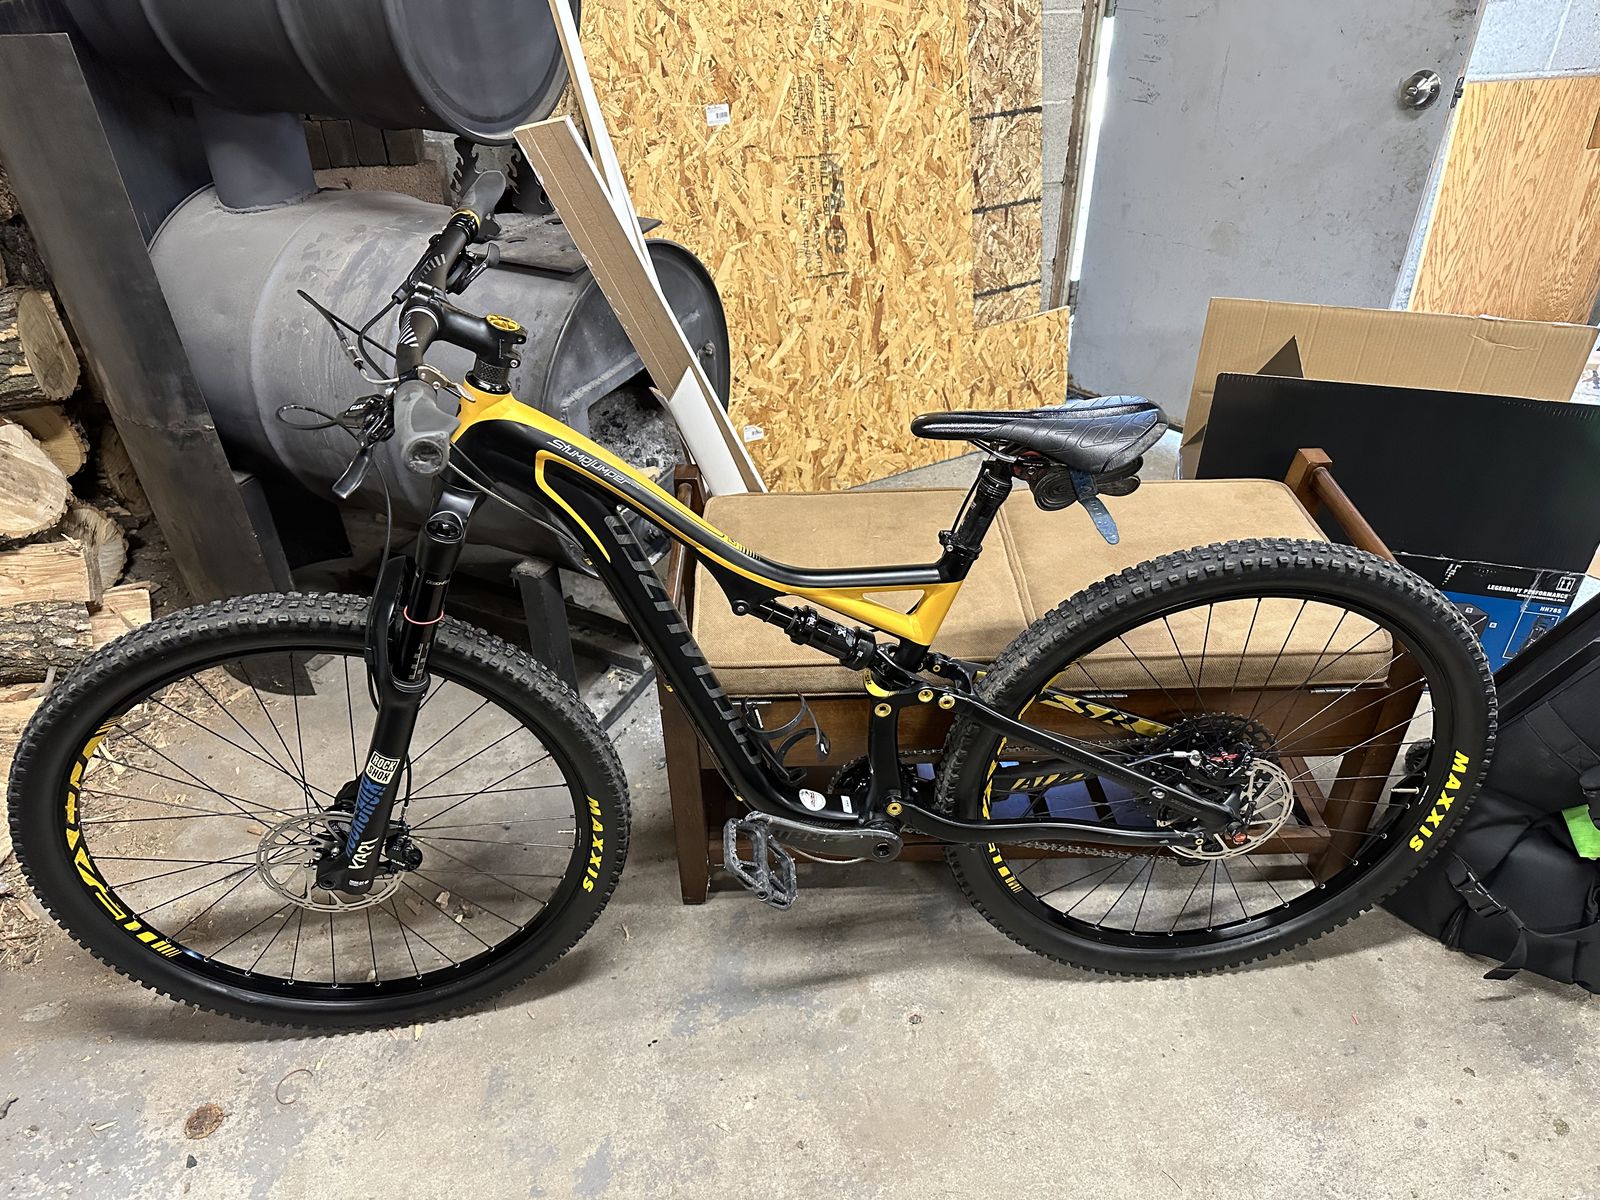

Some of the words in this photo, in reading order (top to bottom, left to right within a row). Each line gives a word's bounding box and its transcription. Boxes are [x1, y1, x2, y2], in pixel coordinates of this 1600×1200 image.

[1487, 584, 1522, 594] LEGENDARY
[1523, 588, 1569, 600] PERFORMANCE
[367, 765, 391, 782] SHOX
[371, 756, 398, 772] ROCK
[1408, 750, 1470, 853] MAXXIS
[348, 836, 379, 870] YARI
[583, 794, 604, 893] MAXXIS
